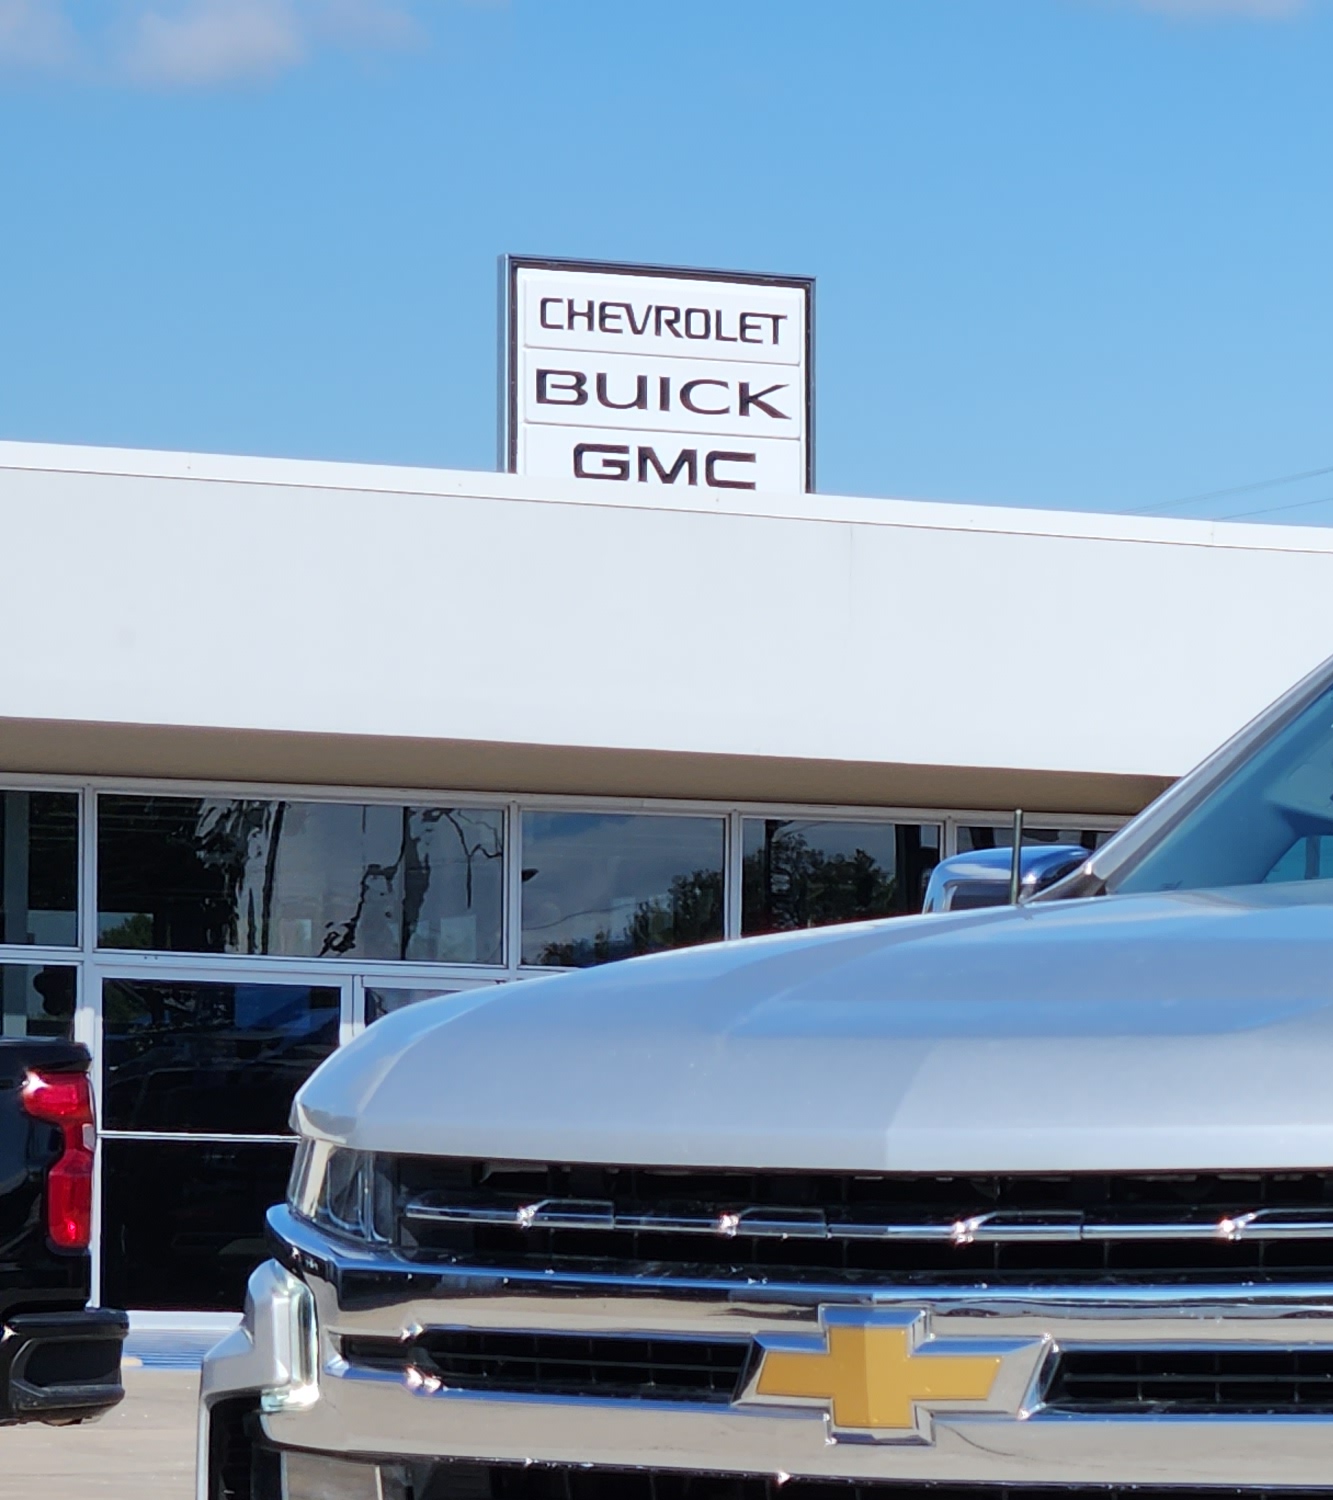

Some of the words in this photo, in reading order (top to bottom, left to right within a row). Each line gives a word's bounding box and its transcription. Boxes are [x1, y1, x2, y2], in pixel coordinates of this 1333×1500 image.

[540, 297, 788, 345] CHEVROLET
[536, 368, 792, 420] BUICK
[573, 443, 757, 490] GMC
